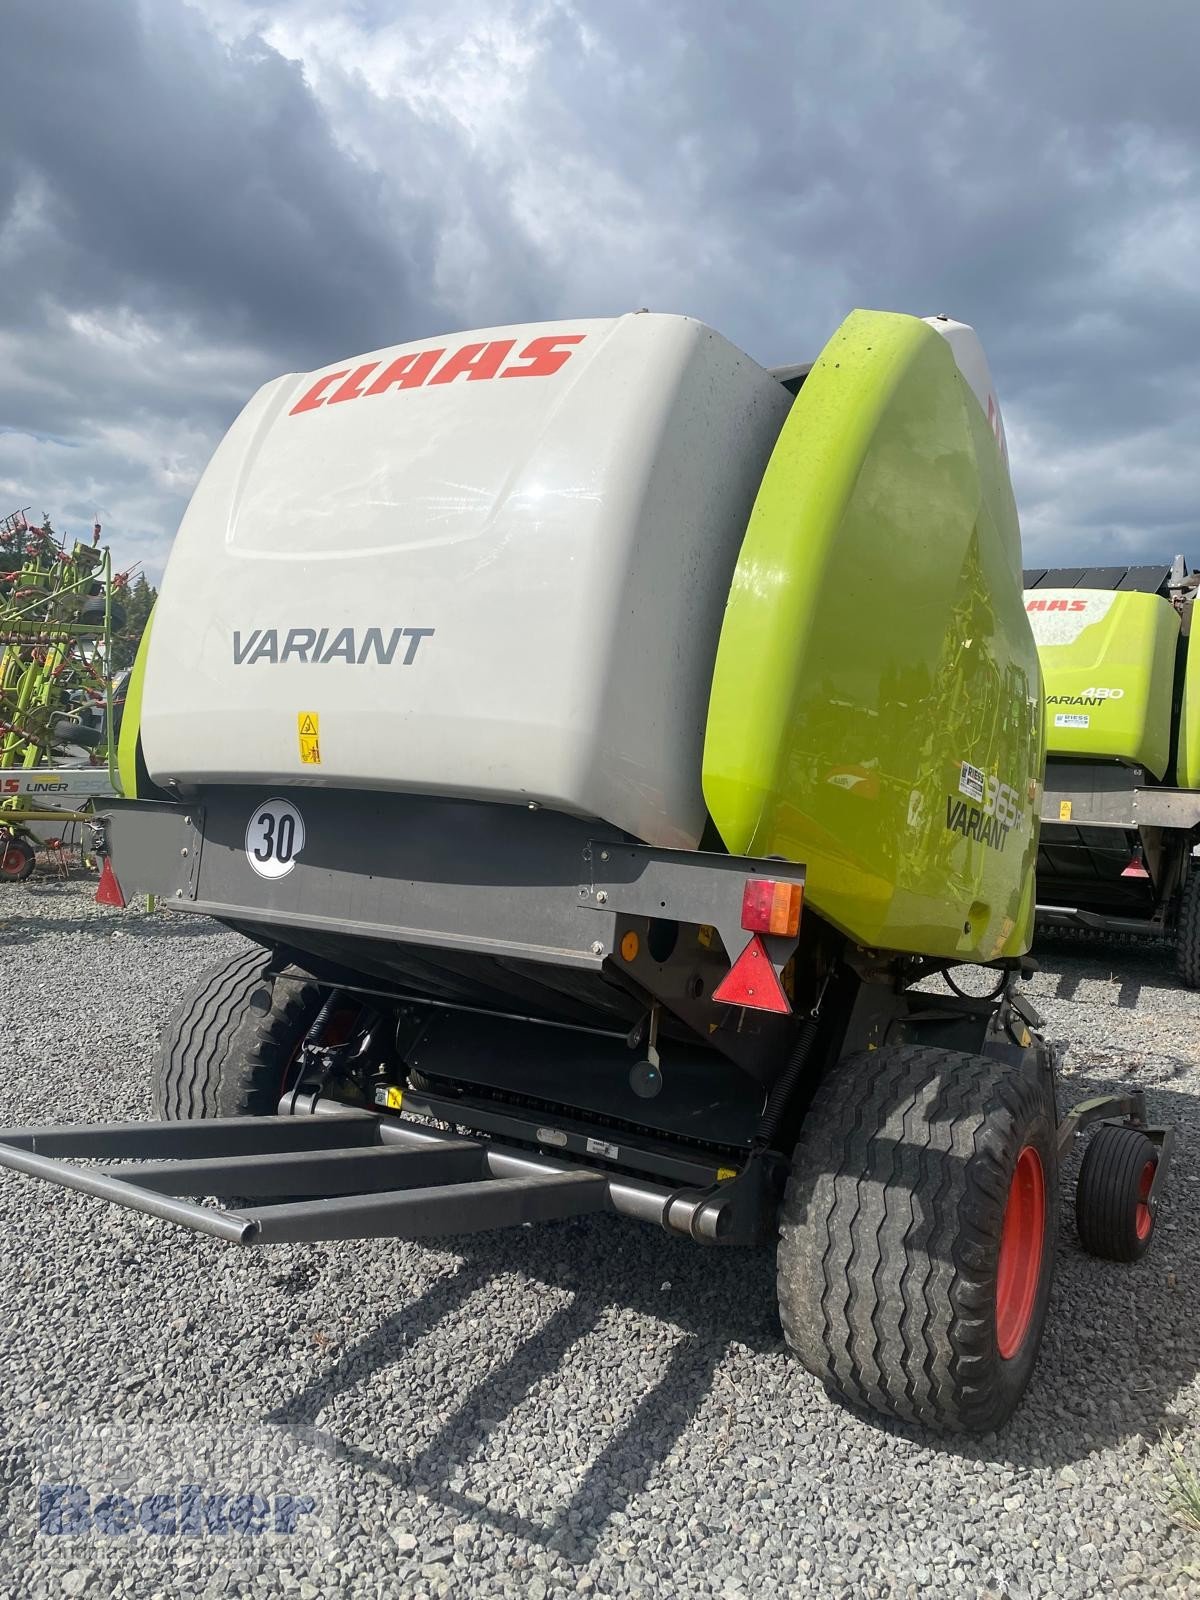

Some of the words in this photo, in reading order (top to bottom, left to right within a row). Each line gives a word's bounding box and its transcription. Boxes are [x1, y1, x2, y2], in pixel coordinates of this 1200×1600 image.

[290, 335, 586, 416] CLAAS
[1026, 600, 1088, 611] AAS
[233, 628, 434, 665] VARIANT
[1080, 687, 1124, 699] 480
[26, 783, 68, 792] LINER
[968, 766, 984, 784] RIESS
[946, 795, 1009, 852] VARIANT
[254, 813, 295, 863] 30
